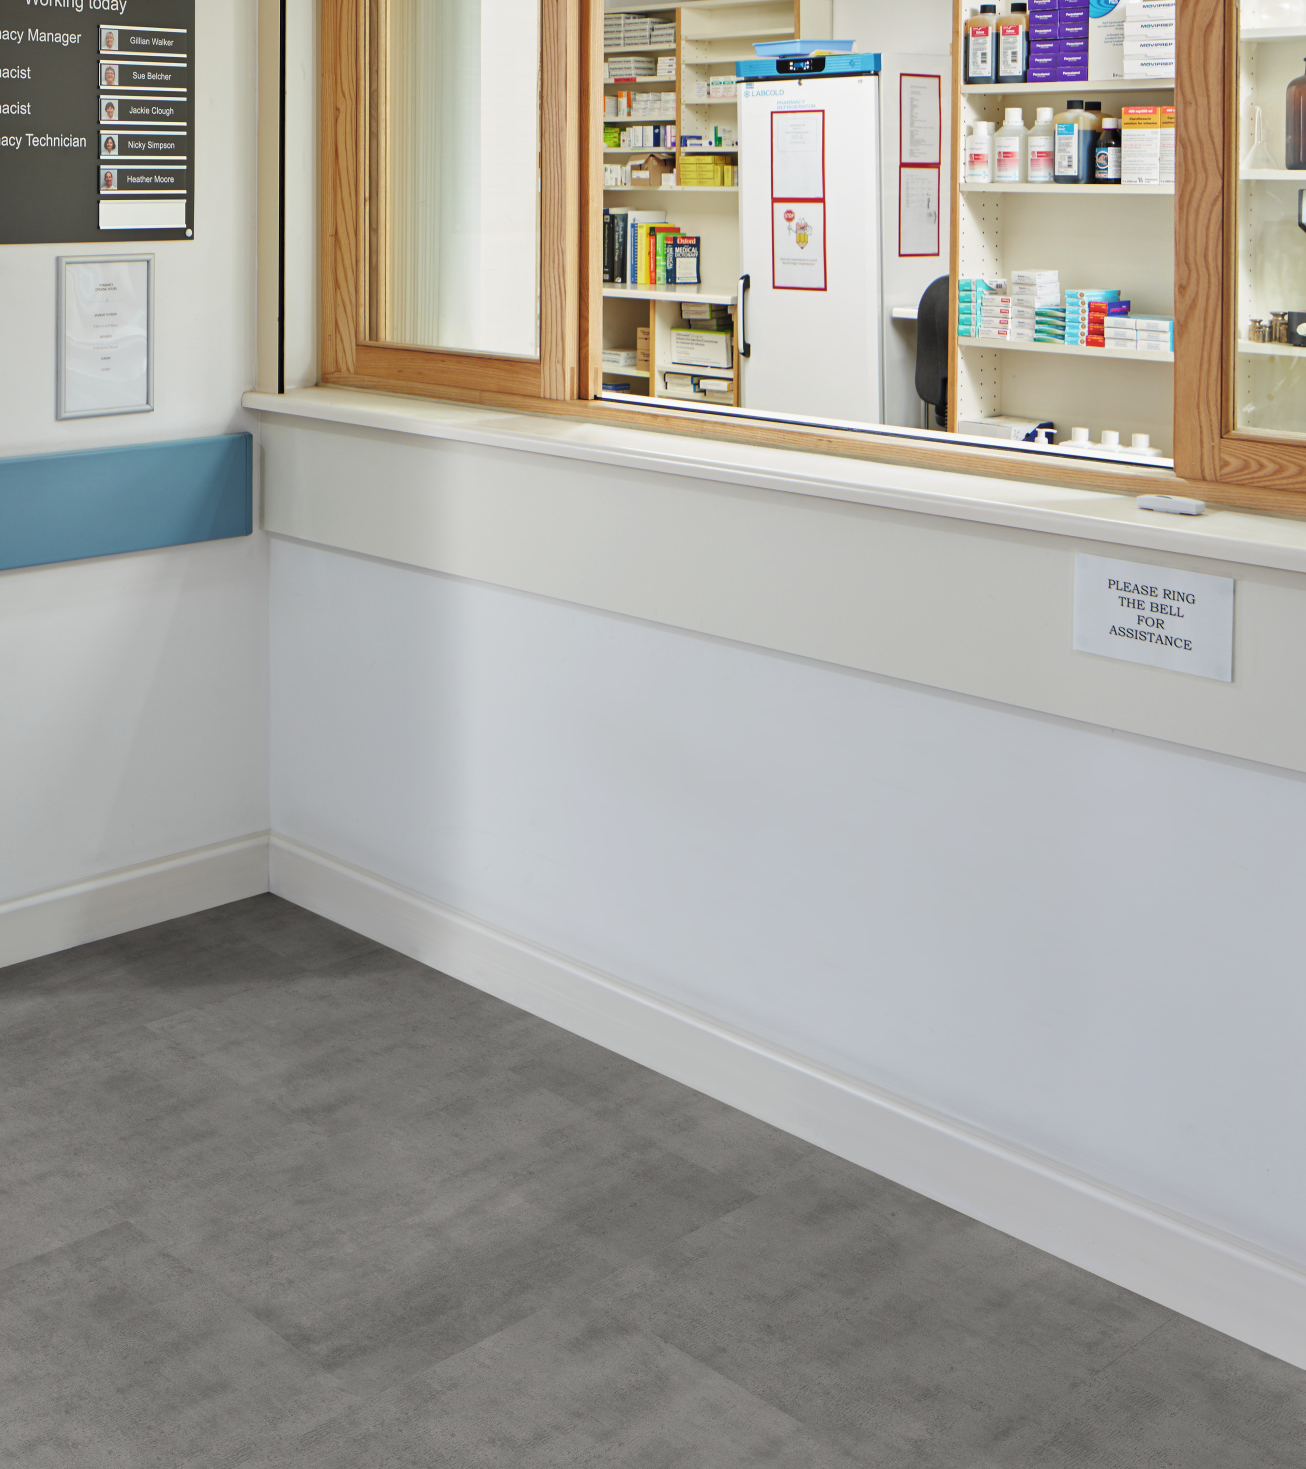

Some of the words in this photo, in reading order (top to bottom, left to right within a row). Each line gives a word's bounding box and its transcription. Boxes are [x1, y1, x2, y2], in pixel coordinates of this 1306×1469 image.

[89, 0, 127, 15] today
[27, 28, 82, 46] Manager
[129, 36, 150, 46] Gillian
[150, 38, 174, 47] Walker
[132, 71, 146, 80] Sue
[147, 72, 172, 81] Belcher
[751, 89, 785, 97] LABCOLD
[128, 106, 150, 115] Jackie
[151, 106, 174, 116] Clough
[25, 133, 87, 147] Technician
[128, 141, 146, 150] Nicky
[147, 141, 175, 151] Simpson
[126, 175, 153, 184] Heather
[154, 175, 175, 183] Moore
[1107, 578, 1159, 598] PLEASE
[1162, 588, 1196, 605] RING
[1117, 595, 1146, 611] THE
[1149, 602, 1185, 618] BELL
[1136, 614, 1165, 630] FOR
[1109, 625, 1192, 651] ASSISTANCE
